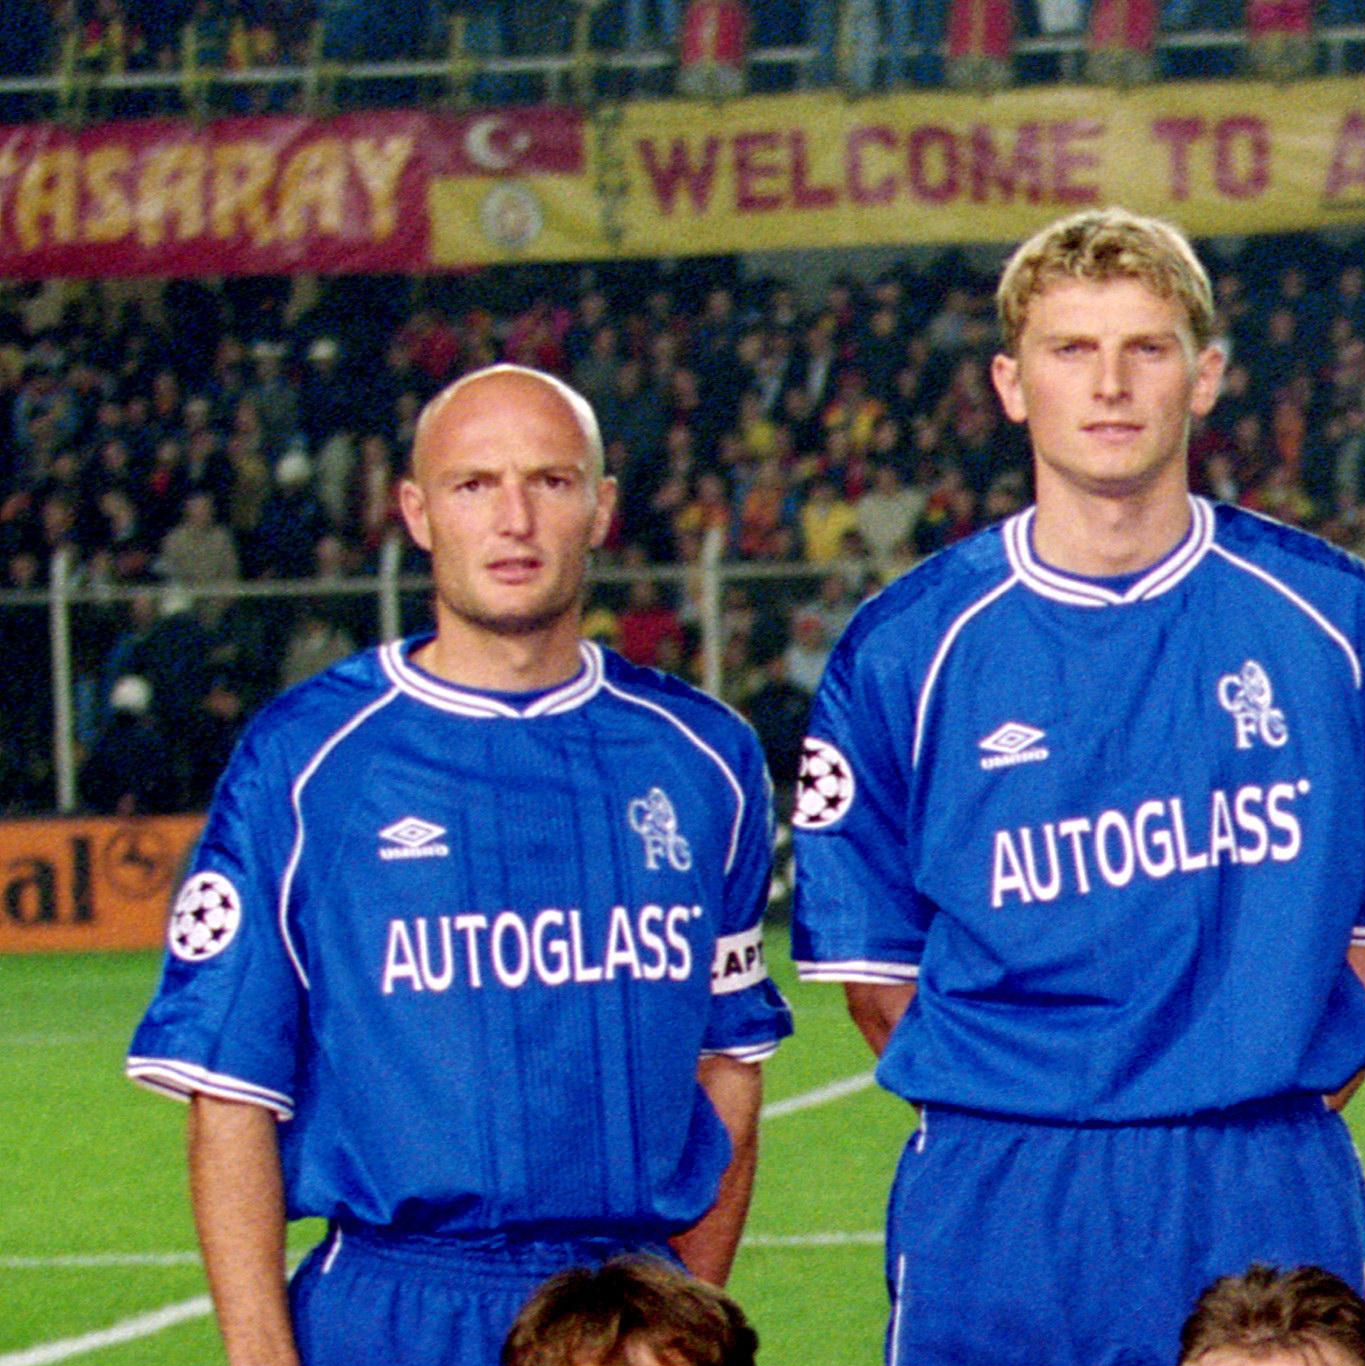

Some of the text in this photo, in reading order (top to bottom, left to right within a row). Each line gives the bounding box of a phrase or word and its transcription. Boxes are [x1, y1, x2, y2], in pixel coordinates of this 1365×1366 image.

[0, 128, 416, 252] ASARAY
[635, 117, 1106, 215] WELCOME
[1150, 115, 1274, 202] TO
[991, 782, 1302, 909] AUTOGLASS
[382, 904, 692, 994] AUTOGLASS
